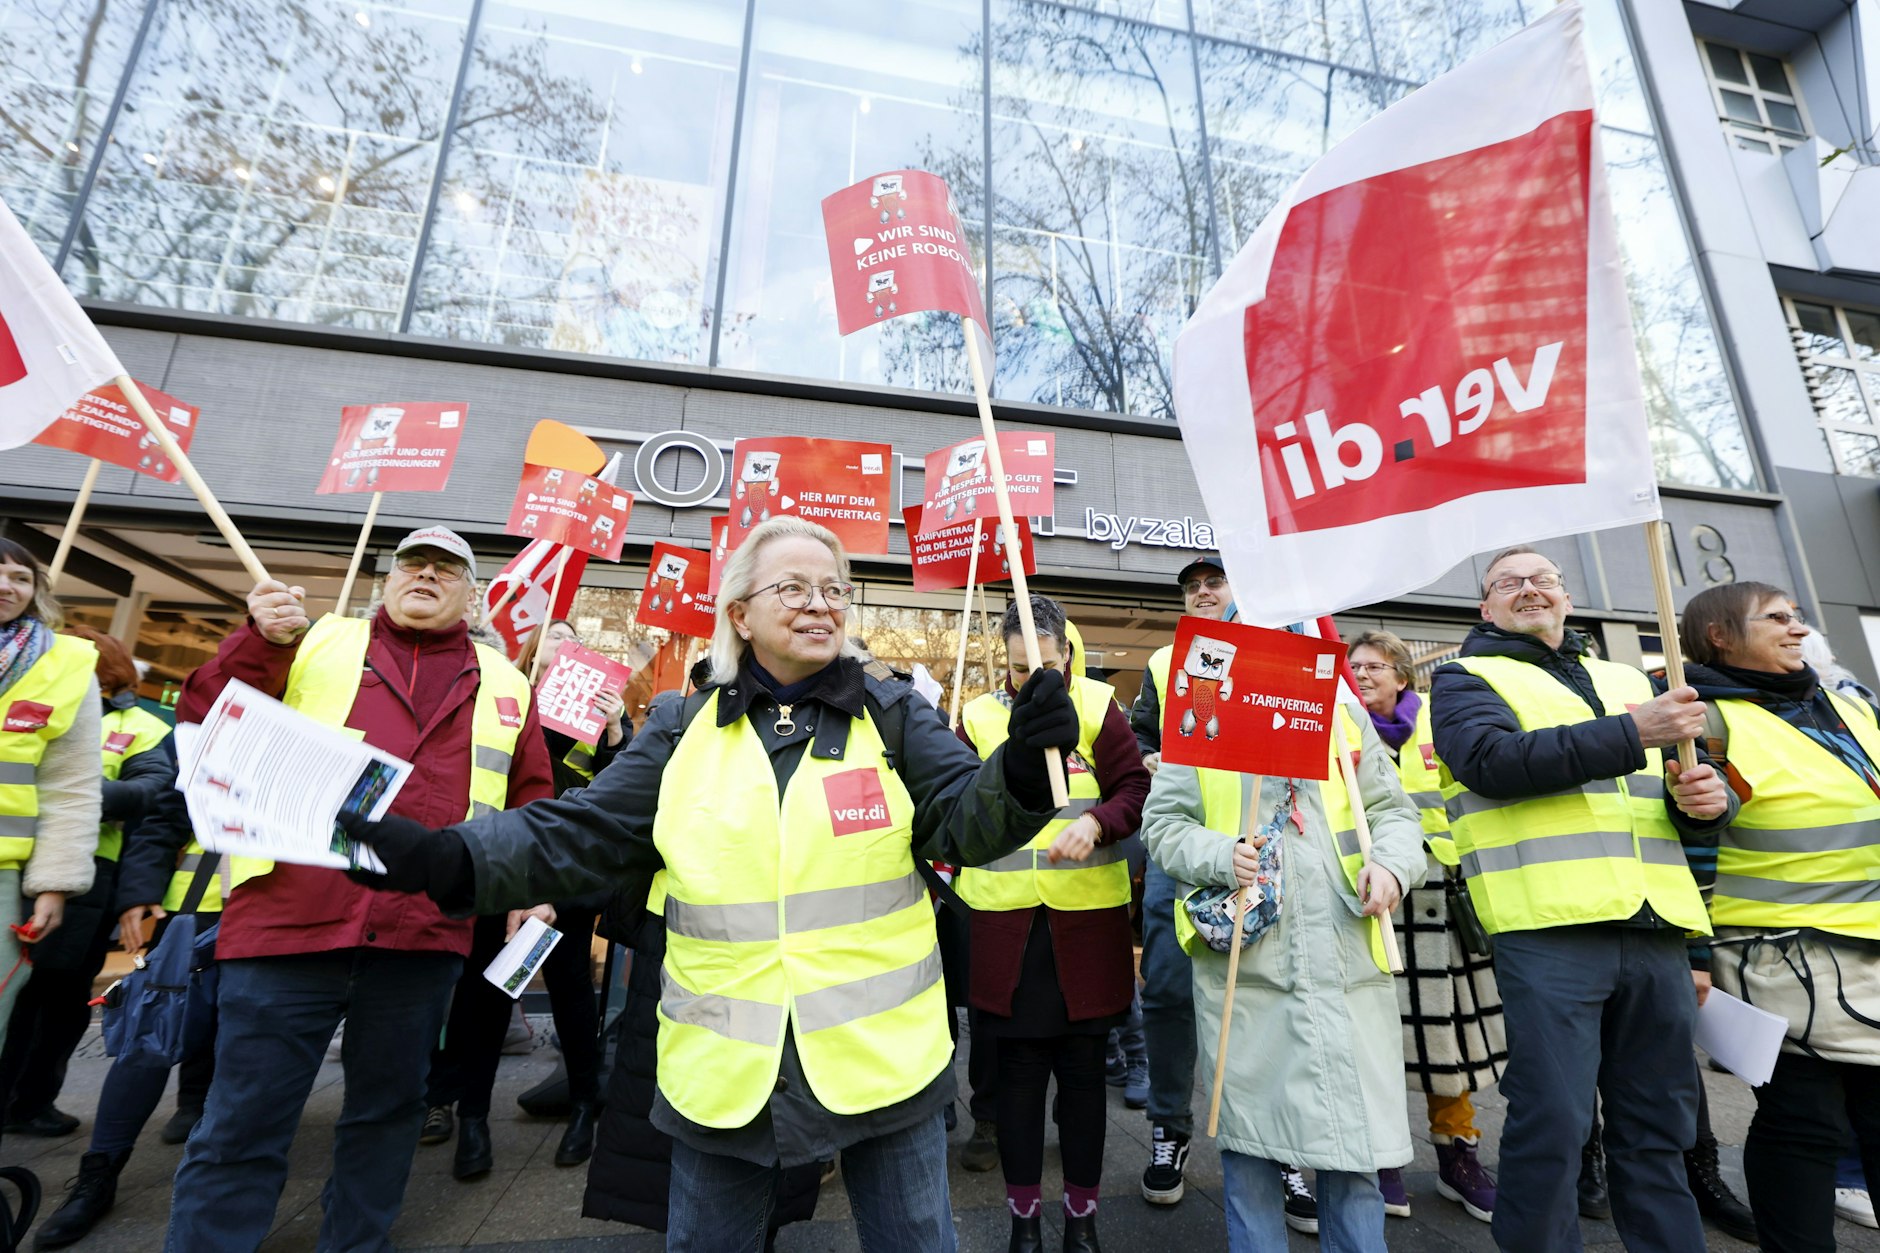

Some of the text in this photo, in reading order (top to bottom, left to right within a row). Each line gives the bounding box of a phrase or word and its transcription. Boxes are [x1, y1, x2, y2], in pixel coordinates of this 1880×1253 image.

[877, 225, 957, 244] WIR SIND
[856, 245, 908, 271] KEINE
[80, 404, 142, 430] ZALANDO
[342, 447, 447, 459] FÜR RESPEKT UND GUTE
[340, 458, 441, 470] ARBEITSBEDINGUNGEN
[934, 486, 950, 500] FÜR
[950, 475, 987, 493] RESPEKT
[1014, 474, 1042, 483] GUTE
[935, 484, 1040, 510] ARBEITSBEDINUNGEN
[539, 495, 577, 508] WIR SIND
[799, 491, 875, 507] HER MIT DEM
[524, 503, 588, 523] KEINE ROBOTER
[798, 505, 881, 521] TARIFVERTRAG
[913, 524, 974, 543] TARIFVERTRAG
[1086, 507, 1137, 550] by
[916, 533, 989, 554] FÜR DIE ZALANO
[917, 545, 985, 565] BESCHÄFTIGTN!
[695, 592, 713, 604] HER
[550, 665, 601, 693] UND
[559, 654, 607, 685] VER
[1242, 692, 1323, 714] »TARIFVERTRAG
[1289, 717, 1324, 732] JETZT!«
[834, 804, 886, 821] ver.di
